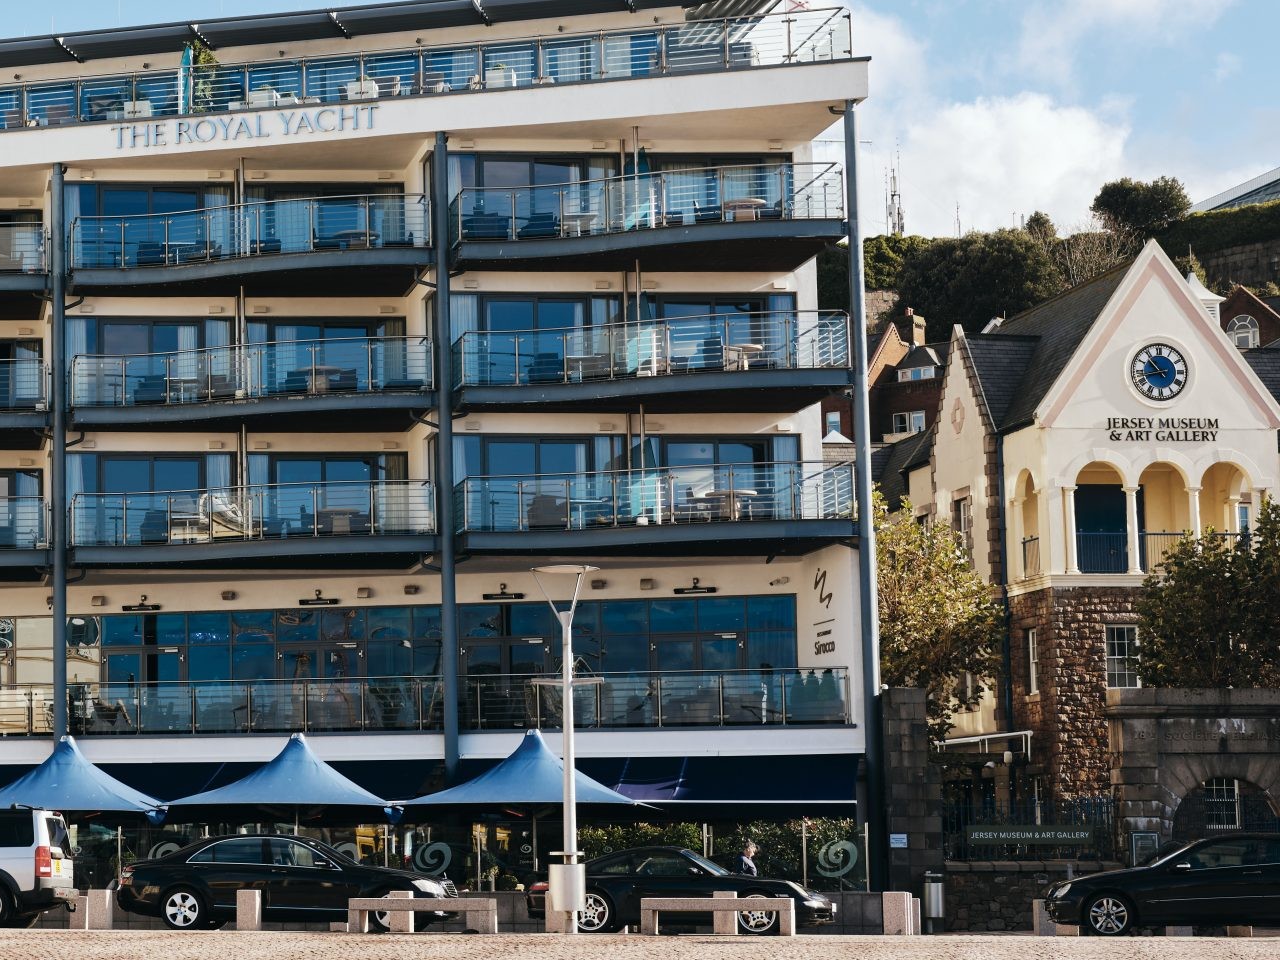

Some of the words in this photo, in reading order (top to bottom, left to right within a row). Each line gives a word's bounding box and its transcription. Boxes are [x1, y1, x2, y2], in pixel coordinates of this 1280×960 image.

[111, 123, 167, 149] THE
[175, 114, 269, 144] ROYAL
[280, 104, 380, 136] YACHT
[1105, 417, 1155, 431] JERSEY
[1158, 417, 1219, 429] MUSEUM
[1109, 430, 1122, 442] &
[1125, 430, 1152, 442] ART
[1155, 430, 1218, 442] GALLERY
[814, 640, 836, 656] Sirocco
[970, 831, 998, 839] JERSEY
[999, 831, 1033, 839] MUSEUM
[1034, 831, 1040, 839] &
[1041, 831, 1055, 839] ART
[1056, 831, 1090, 839] GALLERY
